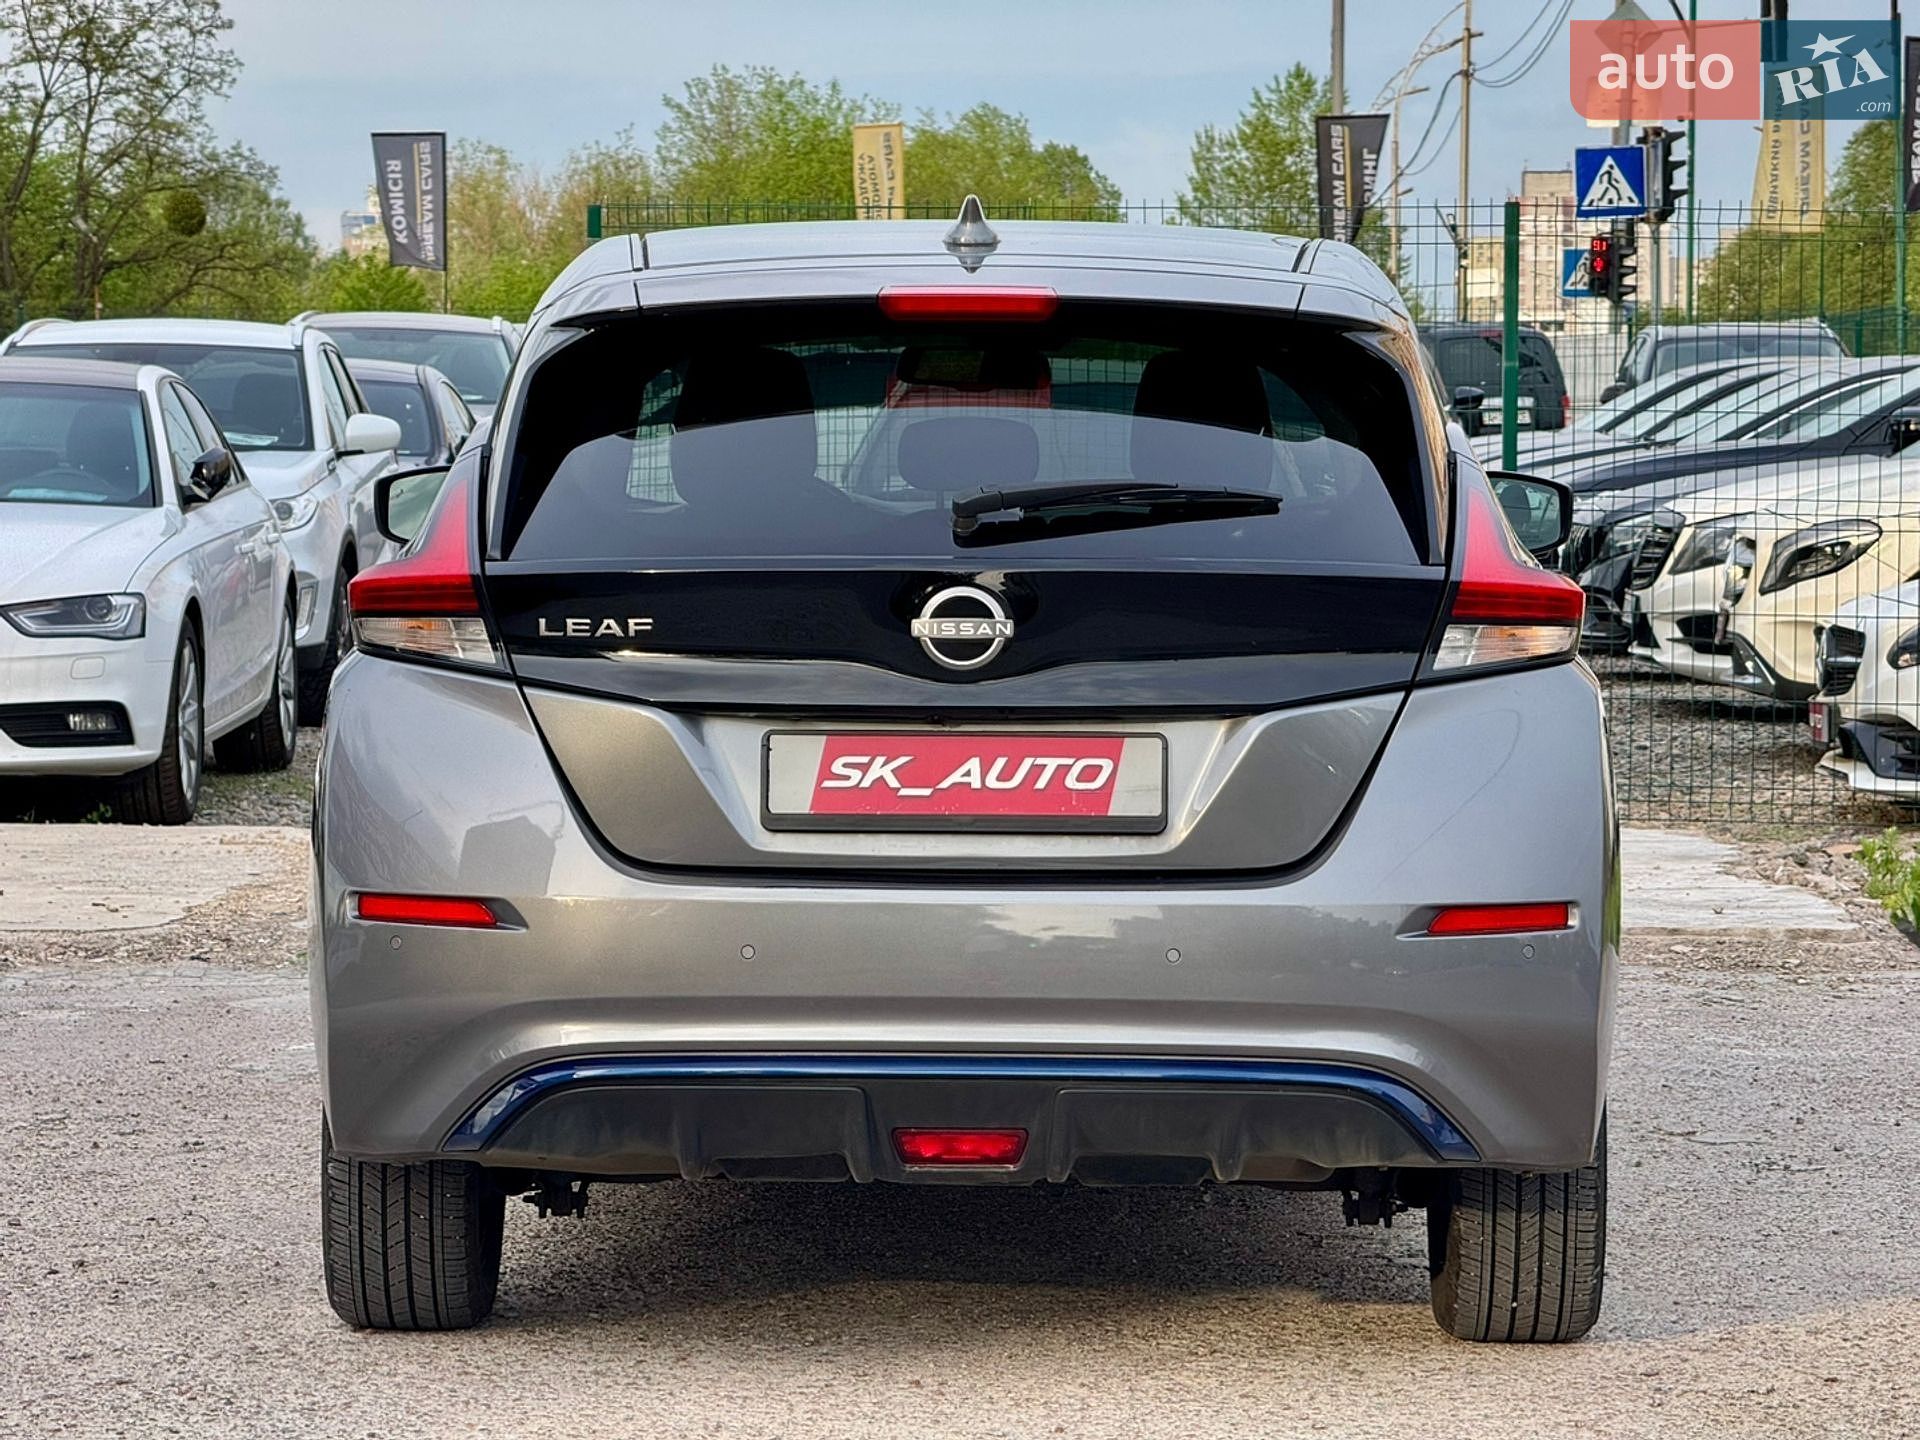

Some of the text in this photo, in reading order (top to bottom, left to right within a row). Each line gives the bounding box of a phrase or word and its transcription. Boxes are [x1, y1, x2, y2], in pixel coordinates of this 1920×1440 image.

[538, 617, 654, 637] LEAF
[913, 621, 1012, 636] NISSAN
[820, 755, 1115, 797] SK_AUTO
